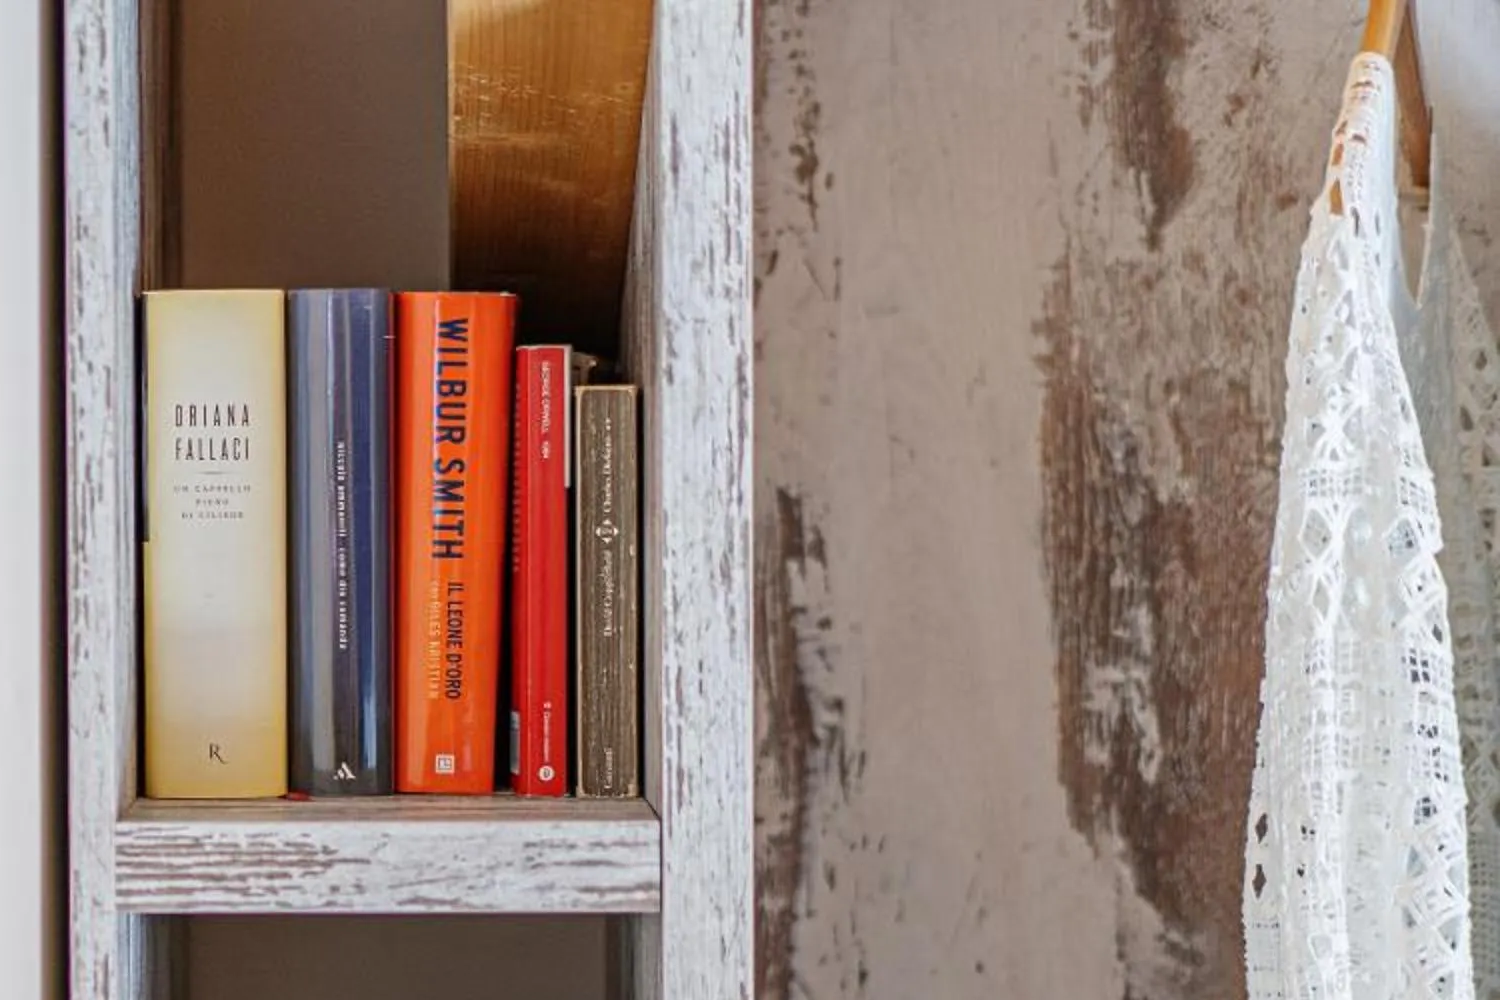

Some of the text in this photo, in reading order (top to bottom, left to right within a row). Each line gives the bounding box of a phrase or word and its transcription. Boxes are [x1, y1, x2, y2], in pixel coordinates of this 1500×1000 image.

[175, 403, 250, 427] ORIANA
[175, 437, 249, 461] FALLACI
[431, 317, 469, 560] WILBUR SMITH
[445, 582, 465, 700] IL LEONE D'ORO
[208, 743, 226, 764] R
